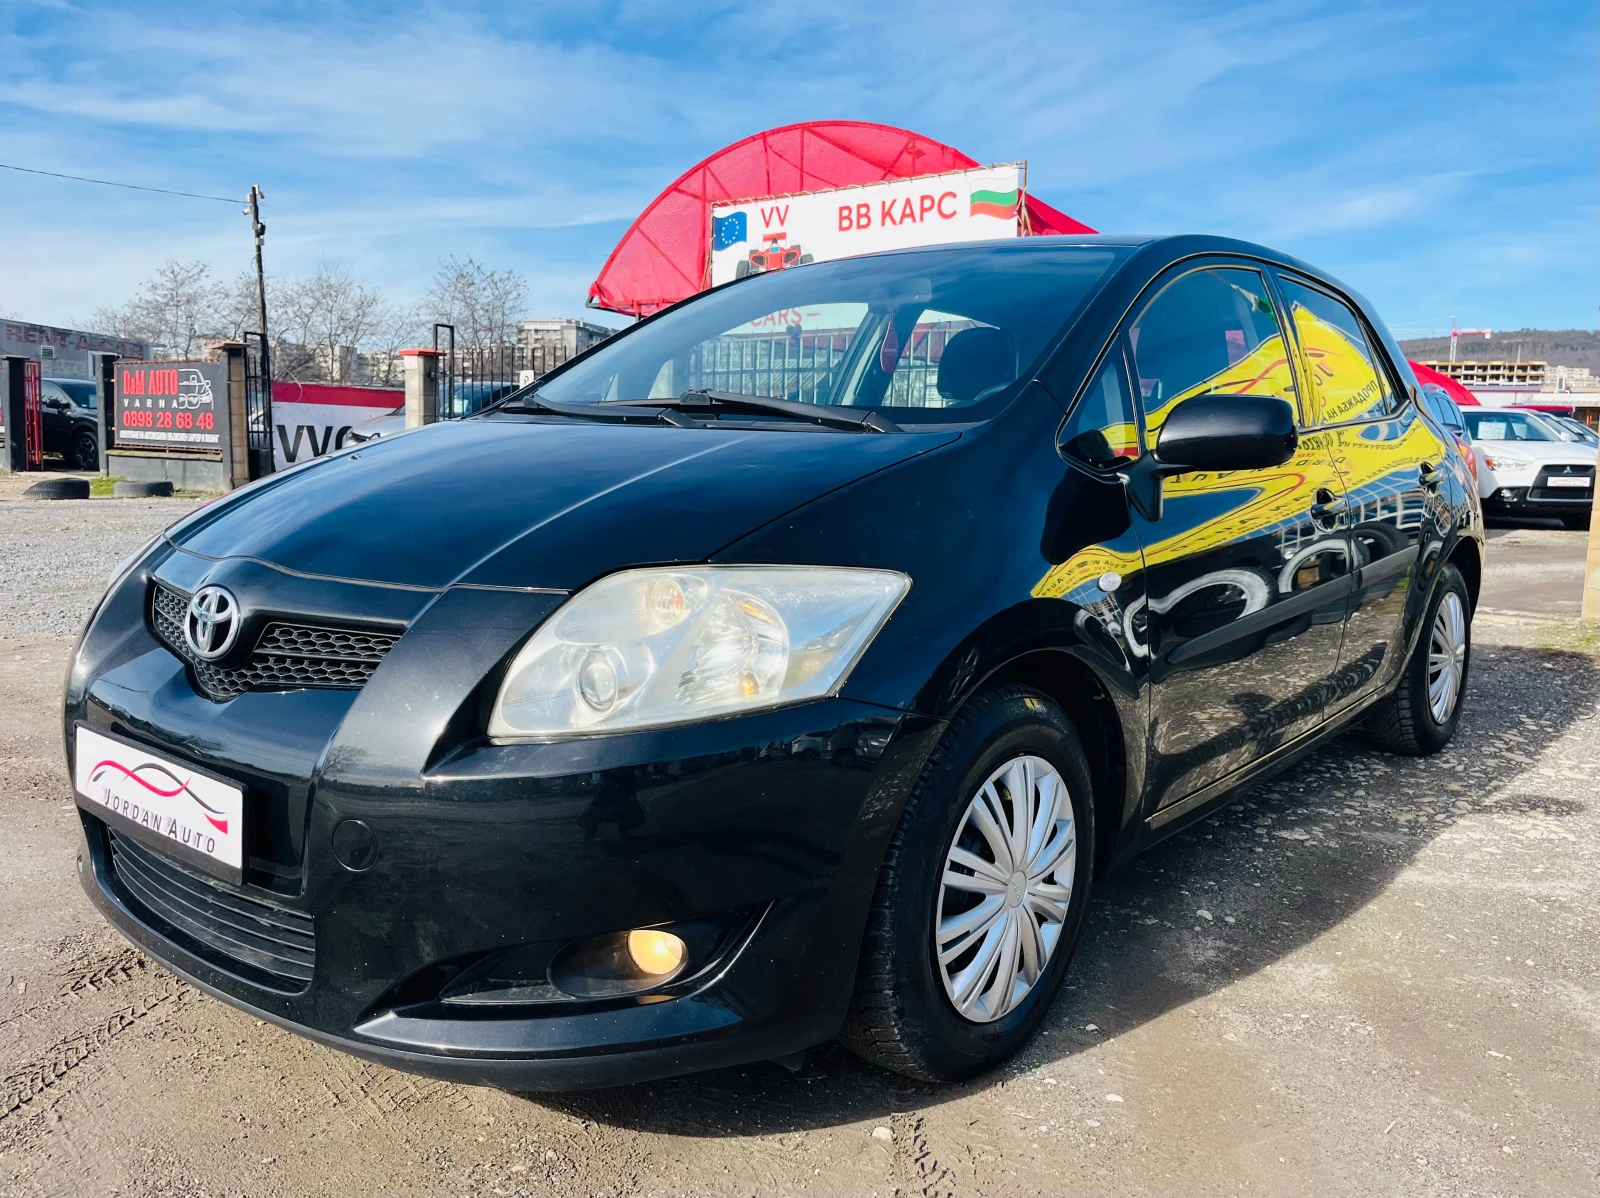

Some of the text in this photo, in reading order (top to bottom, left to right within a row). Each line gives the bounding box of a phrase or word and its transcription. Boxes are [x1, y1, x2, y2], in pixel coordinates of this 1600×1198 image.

[760, 204, 790, 229] VV
[838, 191, 958, 232] ВВ КАРС
[123, 369, 178, 395] D&M AUTO
[123, 398, 178, 409] VARNA
[123, 410, 214, 430] 0898 28 68 48
[104, 787, 216, 854] JORDAN AUTO
